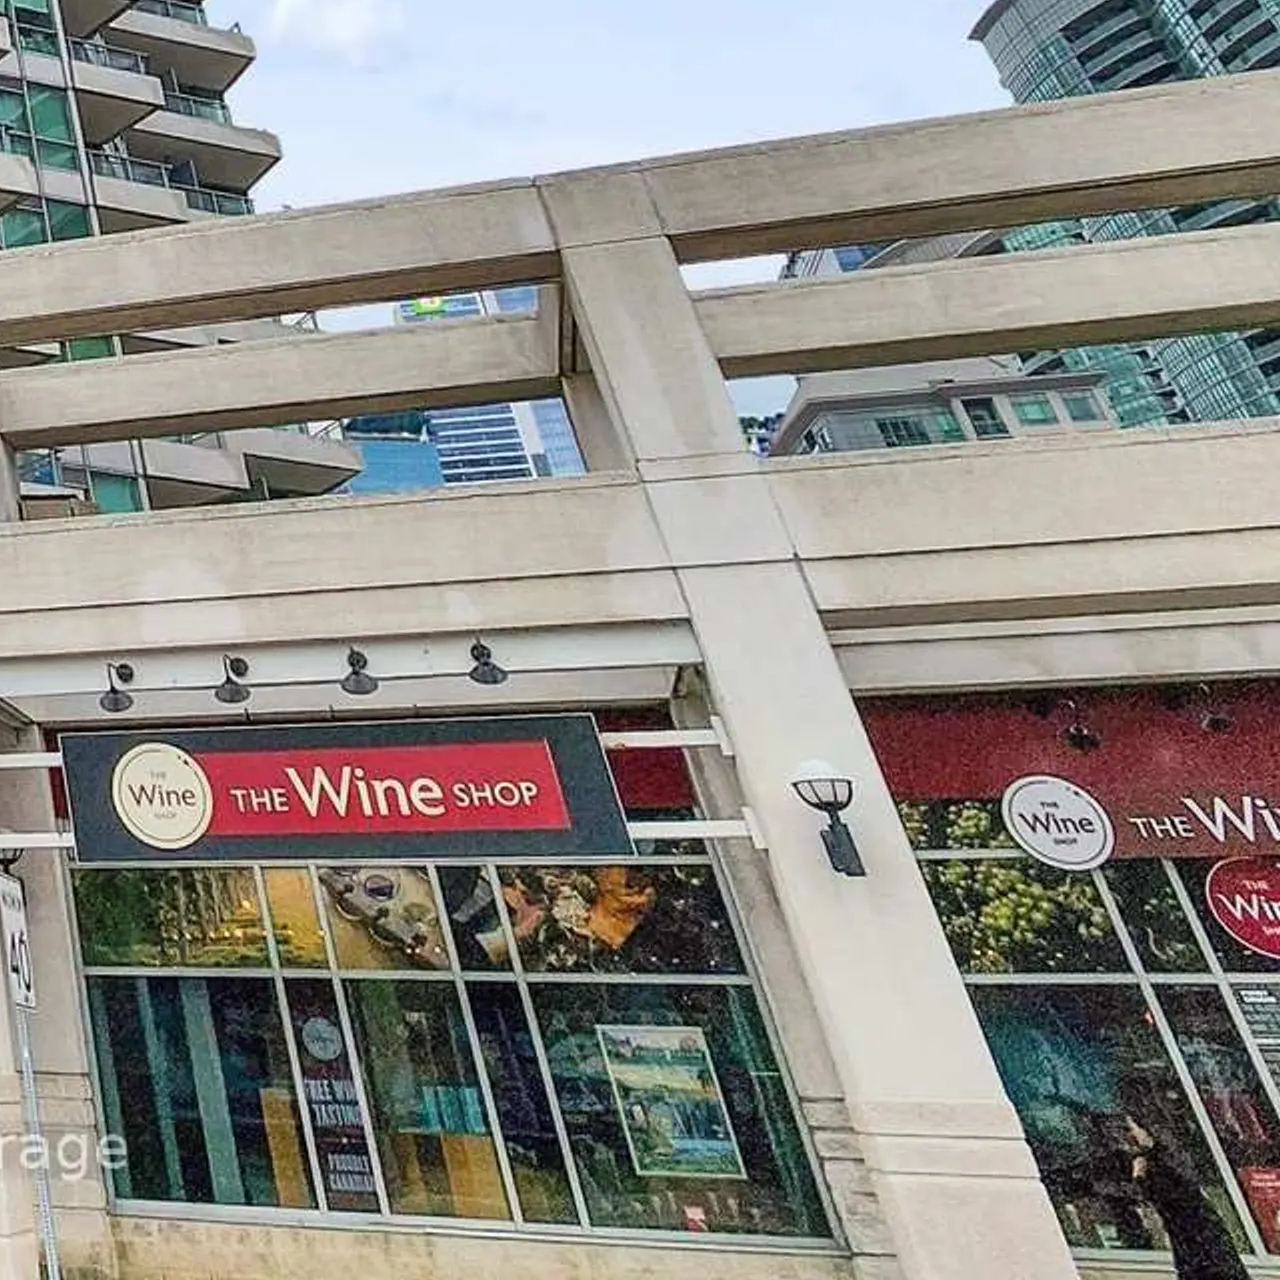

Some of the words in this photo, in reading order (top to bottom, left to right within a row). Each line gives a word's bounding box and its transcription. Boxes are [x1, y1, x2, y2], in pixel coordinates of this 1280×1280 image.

[127, 784, 197, 807] Wine
[230, 787, 290, 813] THE
[285, 765, 447, 818] Wine
[452, 781, 538, 808] SHOP
[1018, 812, 1096, 835] Wine
[1130, 816, 1196, 839] THE
[1181, 795, 1280, 843] Wi
